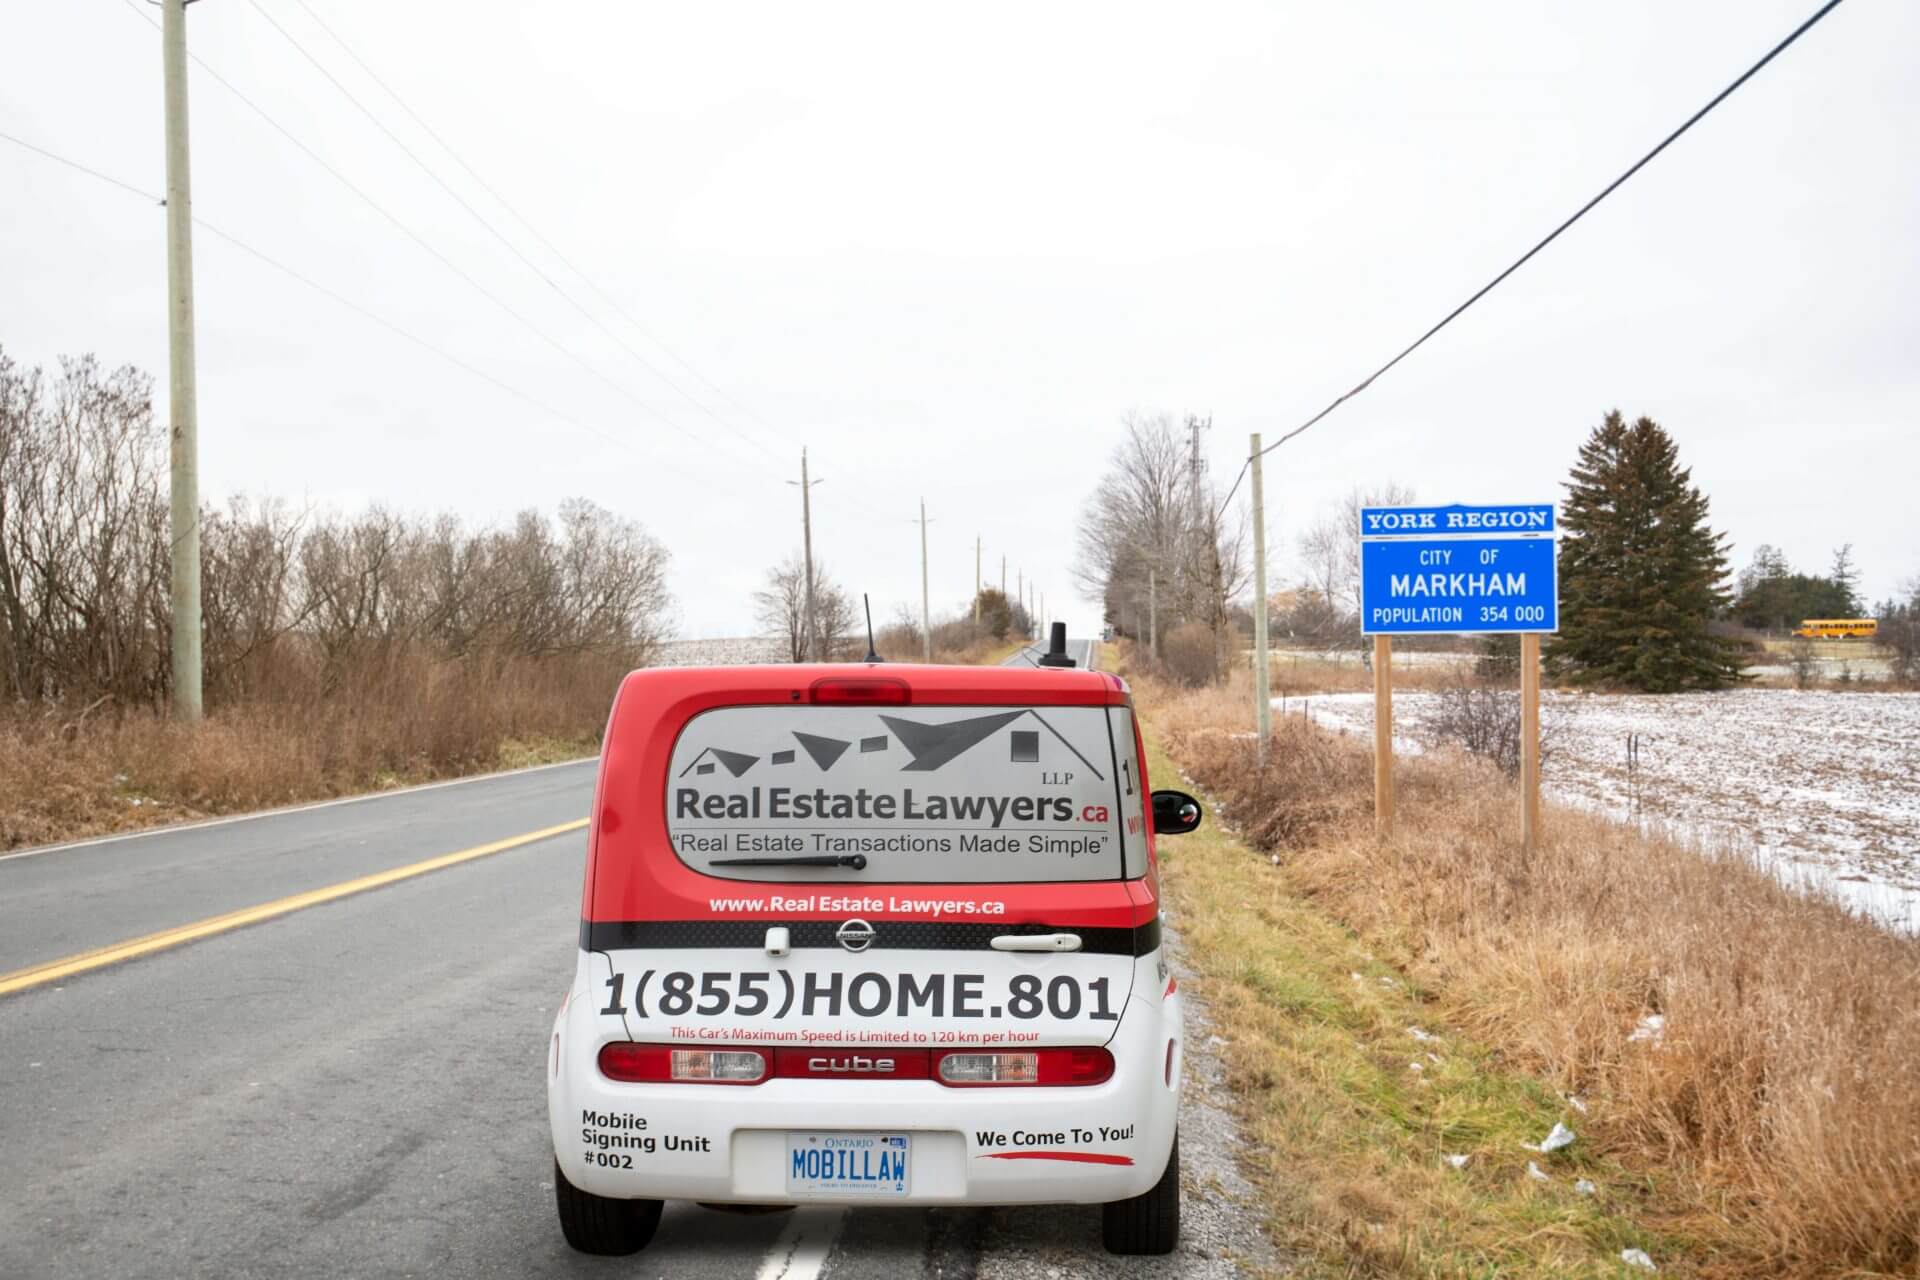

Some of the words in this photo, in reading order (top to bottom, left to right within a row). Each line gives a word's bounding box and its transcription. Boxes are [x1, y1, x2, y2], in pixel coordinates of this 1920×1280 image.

[1368, 513, 1437, 529] YORK
[1447, 511, 1548, 528] REGION
[1420, 550, 1452, 566] CITY
[1480, 549, 1500, 565] OF
[1391, 572, 1527, 598] MARKHAM
[1373, 607, 1463, 623] POPULATION
[1480, 606, 1508, 622] 354
[1515, 605, 1545, 622] 000
[1042, 772, 1074, 785] LLP
[676, 786, 761, 819] Real
[769, 787, 897, 819] Estate
[737, 833, 804, 852] Estate
[811, 833, 952, 854] Transactions
[960, 834, 1020, 853] Made
[709, 896, 816, 912] www.Real
[820, 896, 884, 913] Estate
[889, 897, 1005, 917] Lawyers.ca
[600, 969, 1119, 1022] 1(855)HOME.801
[671, 1027, 696, 1039] This
[732, 1028, 798, 1041] Maximum
[801, 1029, 842, 1044] Speed
[845, 1030, 857, 1042] is
[859, 1031, 910, 1043] Limited
[913, 1031, 927, 1043] to
[932, 1031, 955, 1043] 120
[958, 1031, 979, 1043] km
[983, 1032, 1005, 1046] per
[1008, 1030, 1041, 1042] hour
[808, 1055, 896, 1072] cube
[582, 1128, 656, 1154] Signing
[664, 1135, 711, 1153] Unit
[976, 1131, 1007, 1147] We
[1013, 1130, 1066, 1146] Come
[1071, 1128, 1094, 1144] To
[1099, 1123, 1135, 1143] You!
[584, 1150, 633, 1170] #002
[793, 1149, 906, 1182] MOBILLAW
